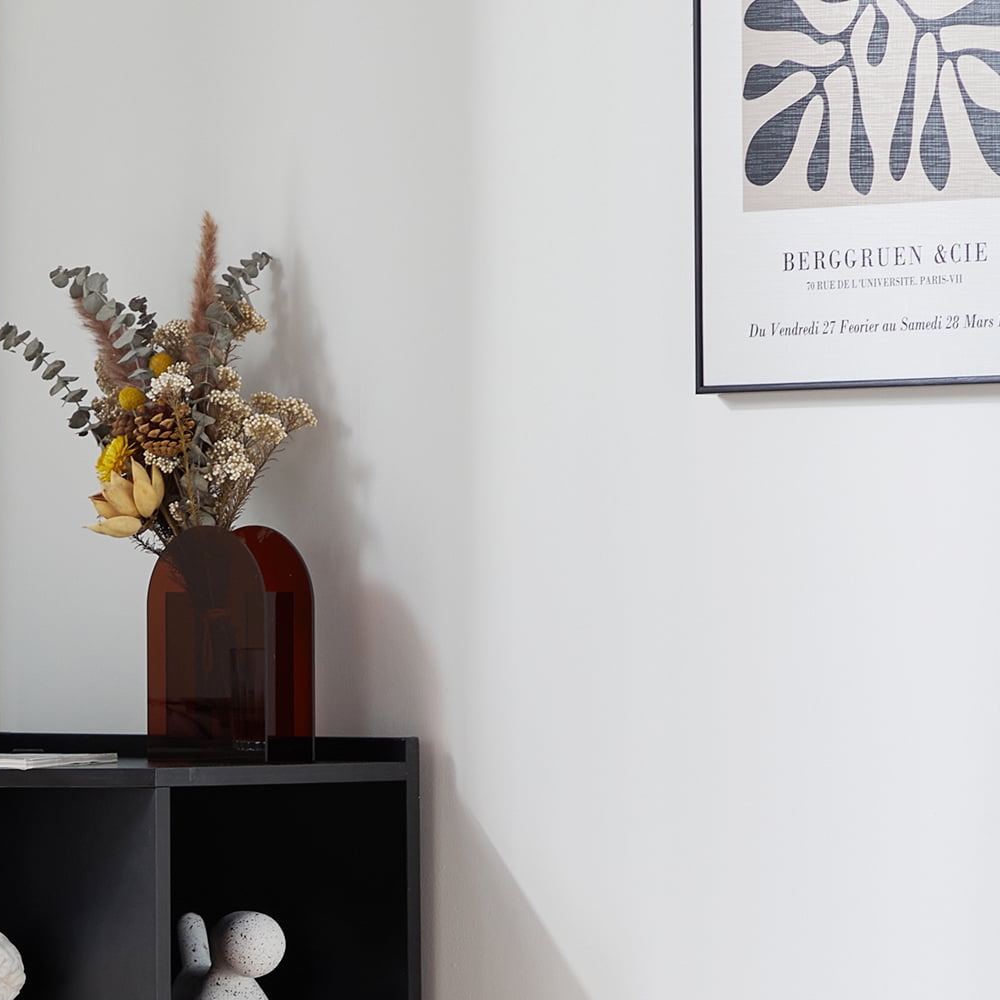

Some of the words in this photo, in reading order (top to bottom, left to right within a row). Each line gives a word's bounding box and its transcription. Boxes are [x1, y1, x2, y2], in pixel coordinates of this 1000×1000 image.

[783, 245, 922, 272] BERGGRUEN
[934, 241, 988, 264] &CIE
[817, 280, 836, 290] RUE
[837, 279, 850, 289] DE
[920, 274, 963, 285] PARIS-VII
[749, 323, 766, 338] Du
[771, 321, 820, 337] Vendredi
[822, 320, 836, 335] 27
[882, 323, 896, 333] au
[900, 315, 942, 332] Samedi
[946, 315, 960, 330] 28
[963, 313, 994, 329] Mars
